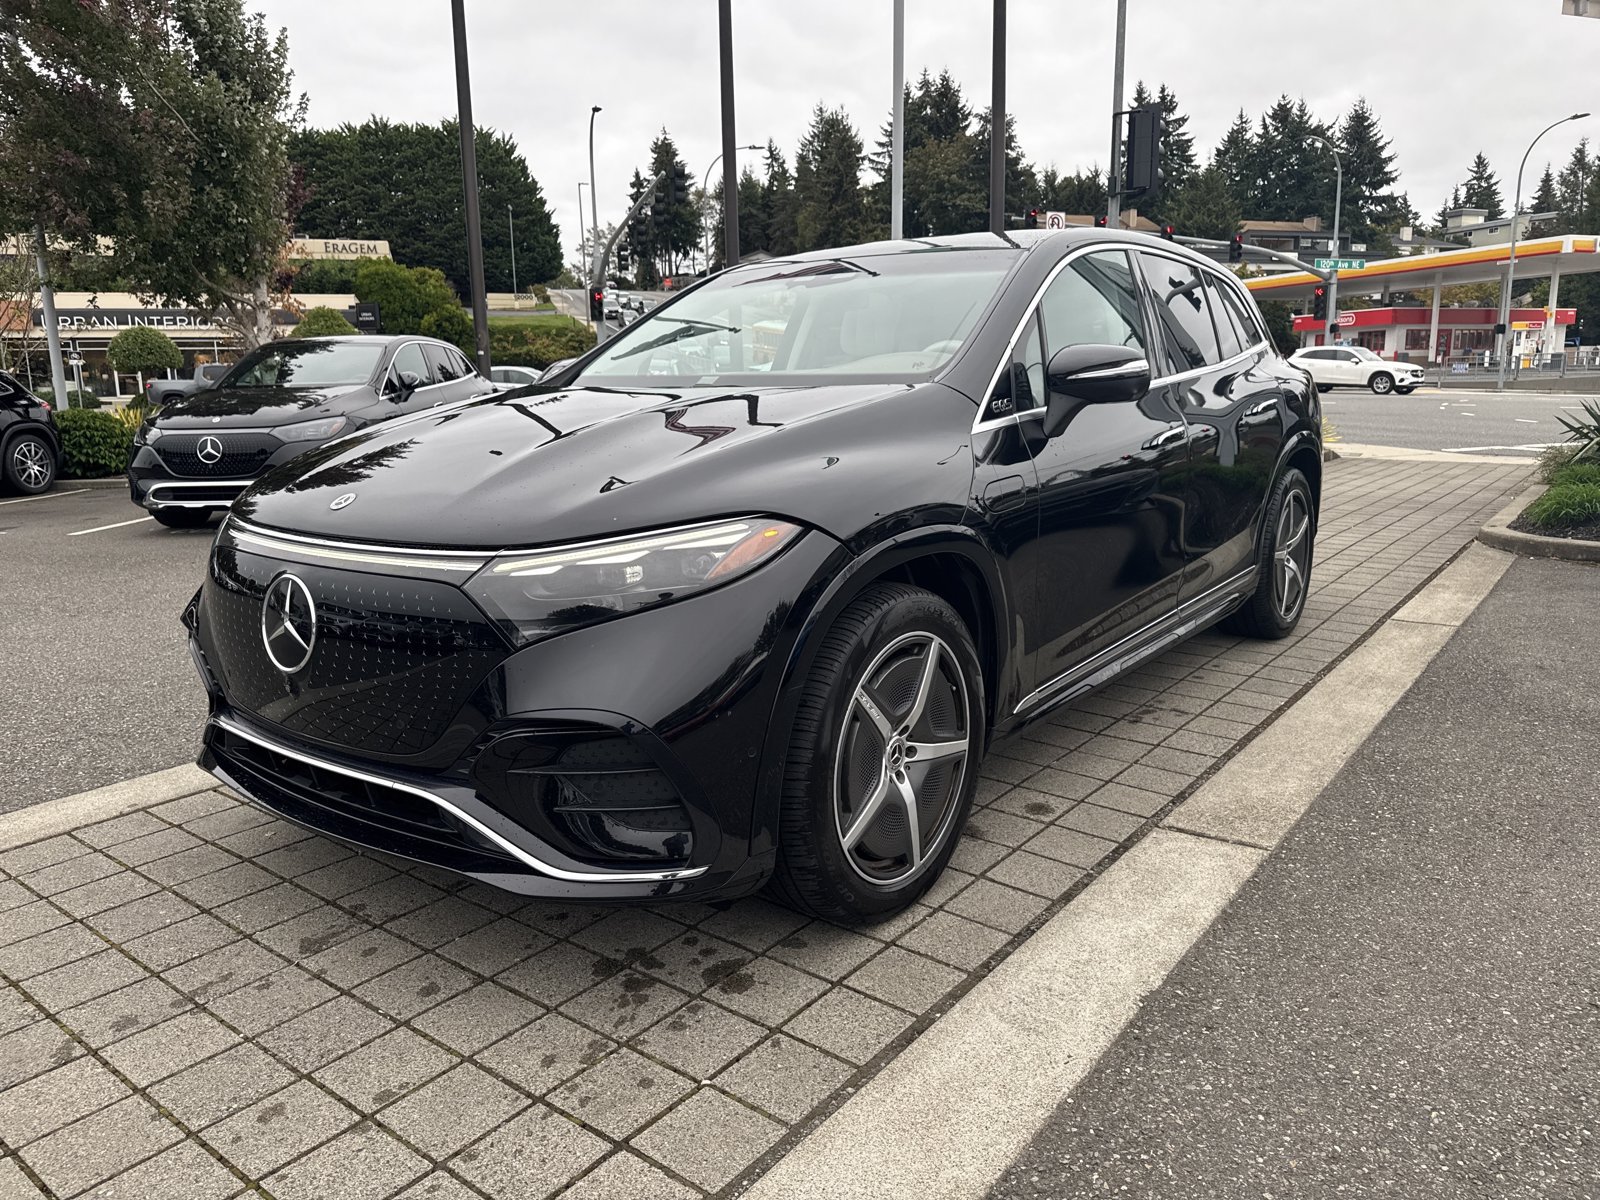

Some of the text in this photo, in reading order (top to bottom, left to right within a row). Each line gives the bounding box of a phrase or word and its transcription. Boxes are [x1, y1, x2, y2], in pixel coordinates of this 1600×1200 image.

[1337, 261, 1349, 269] Ave
[1351, 261, 1360, 269] NE
[992, 398, 1013, 413] EQS
